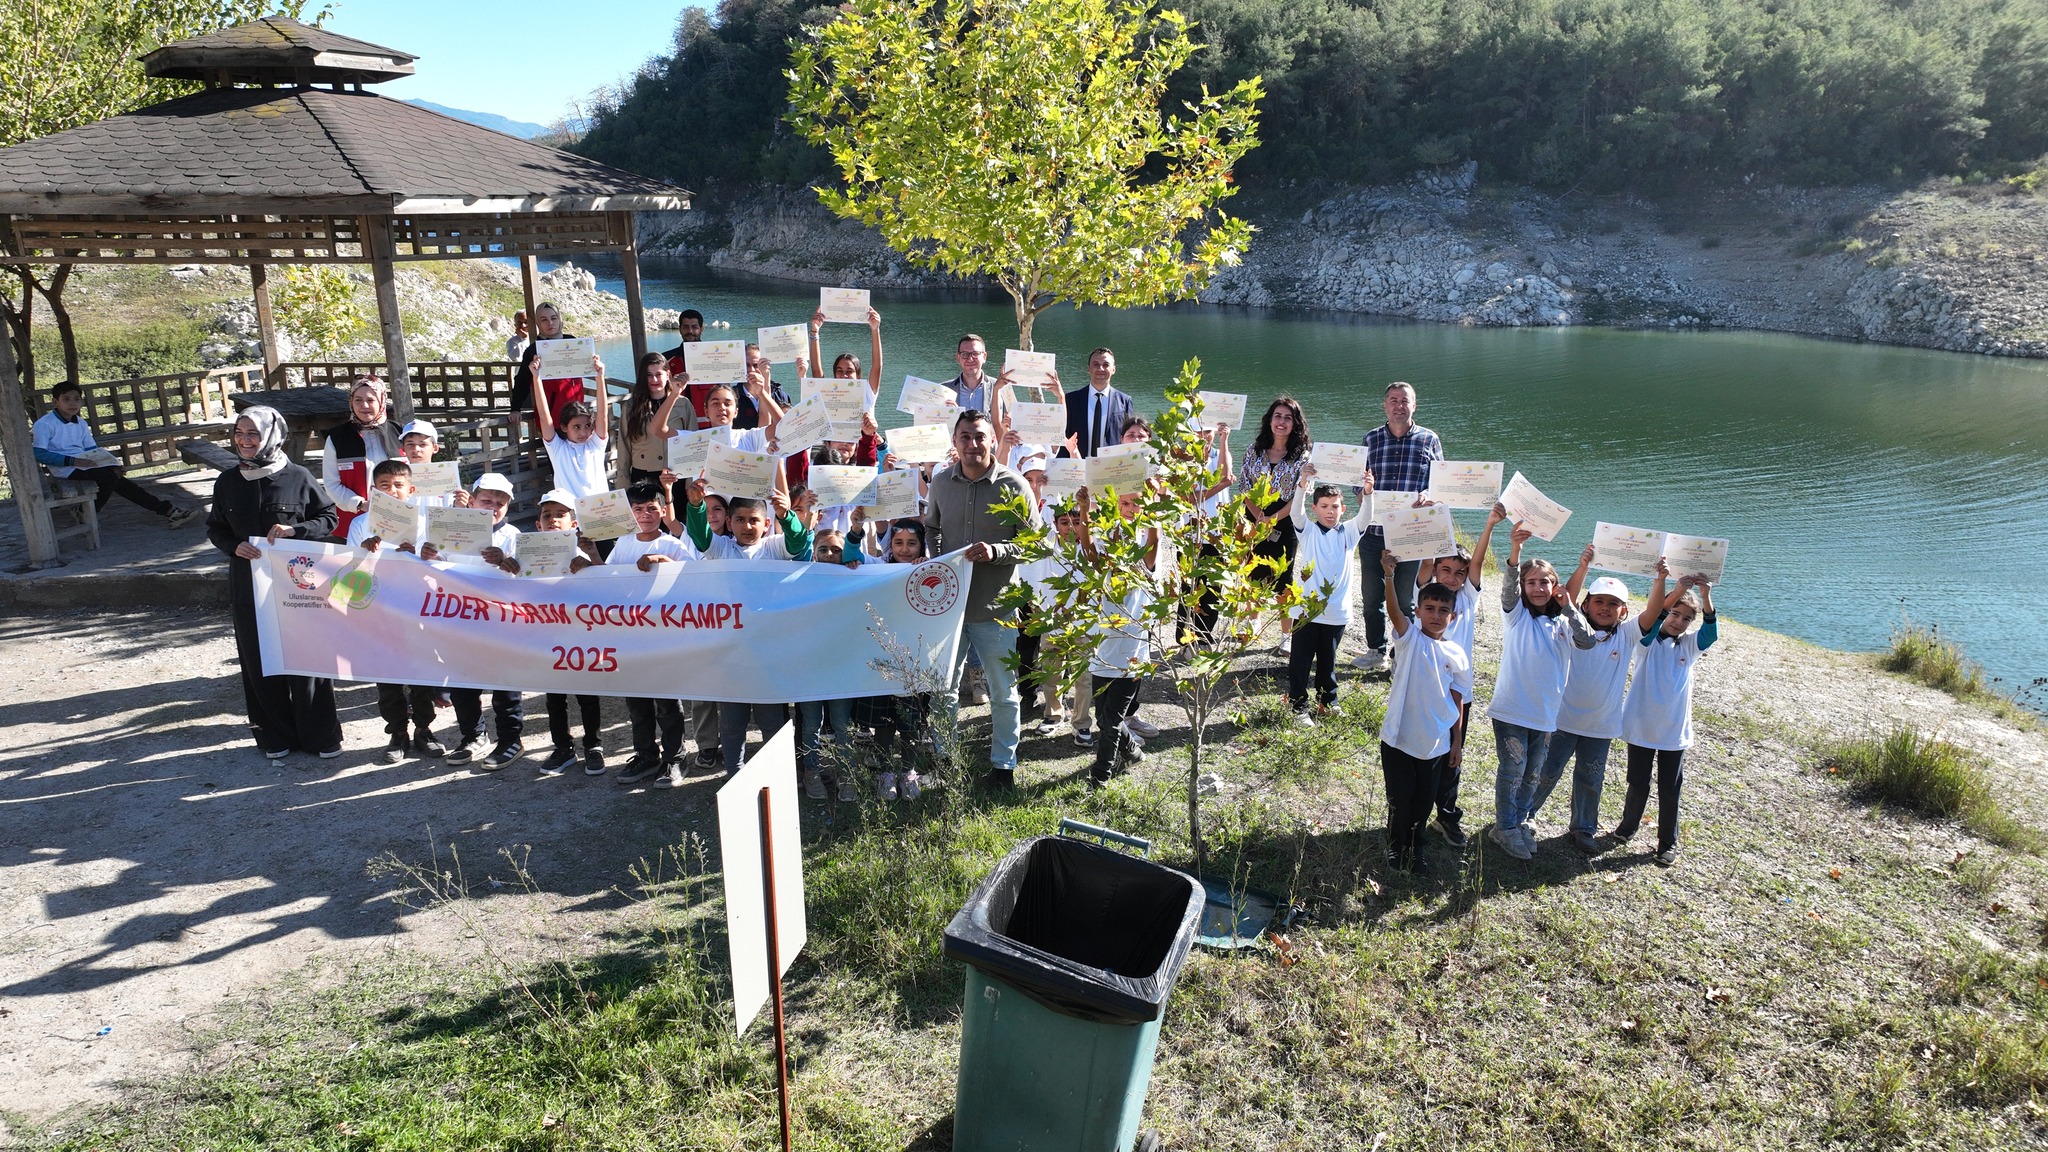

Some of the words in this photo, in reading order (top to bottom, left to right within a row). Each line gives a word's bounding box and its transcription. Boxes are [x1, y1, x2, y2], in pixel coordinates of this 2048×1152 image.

[420, 586, 490, 621] LİDER
[491, 600, 572, 625] TARIM
[575, 603, 657, 632] ÇOCUK
[660, 602, 744, 629] KAMPI
[552, 645, 618, 672] 2025
